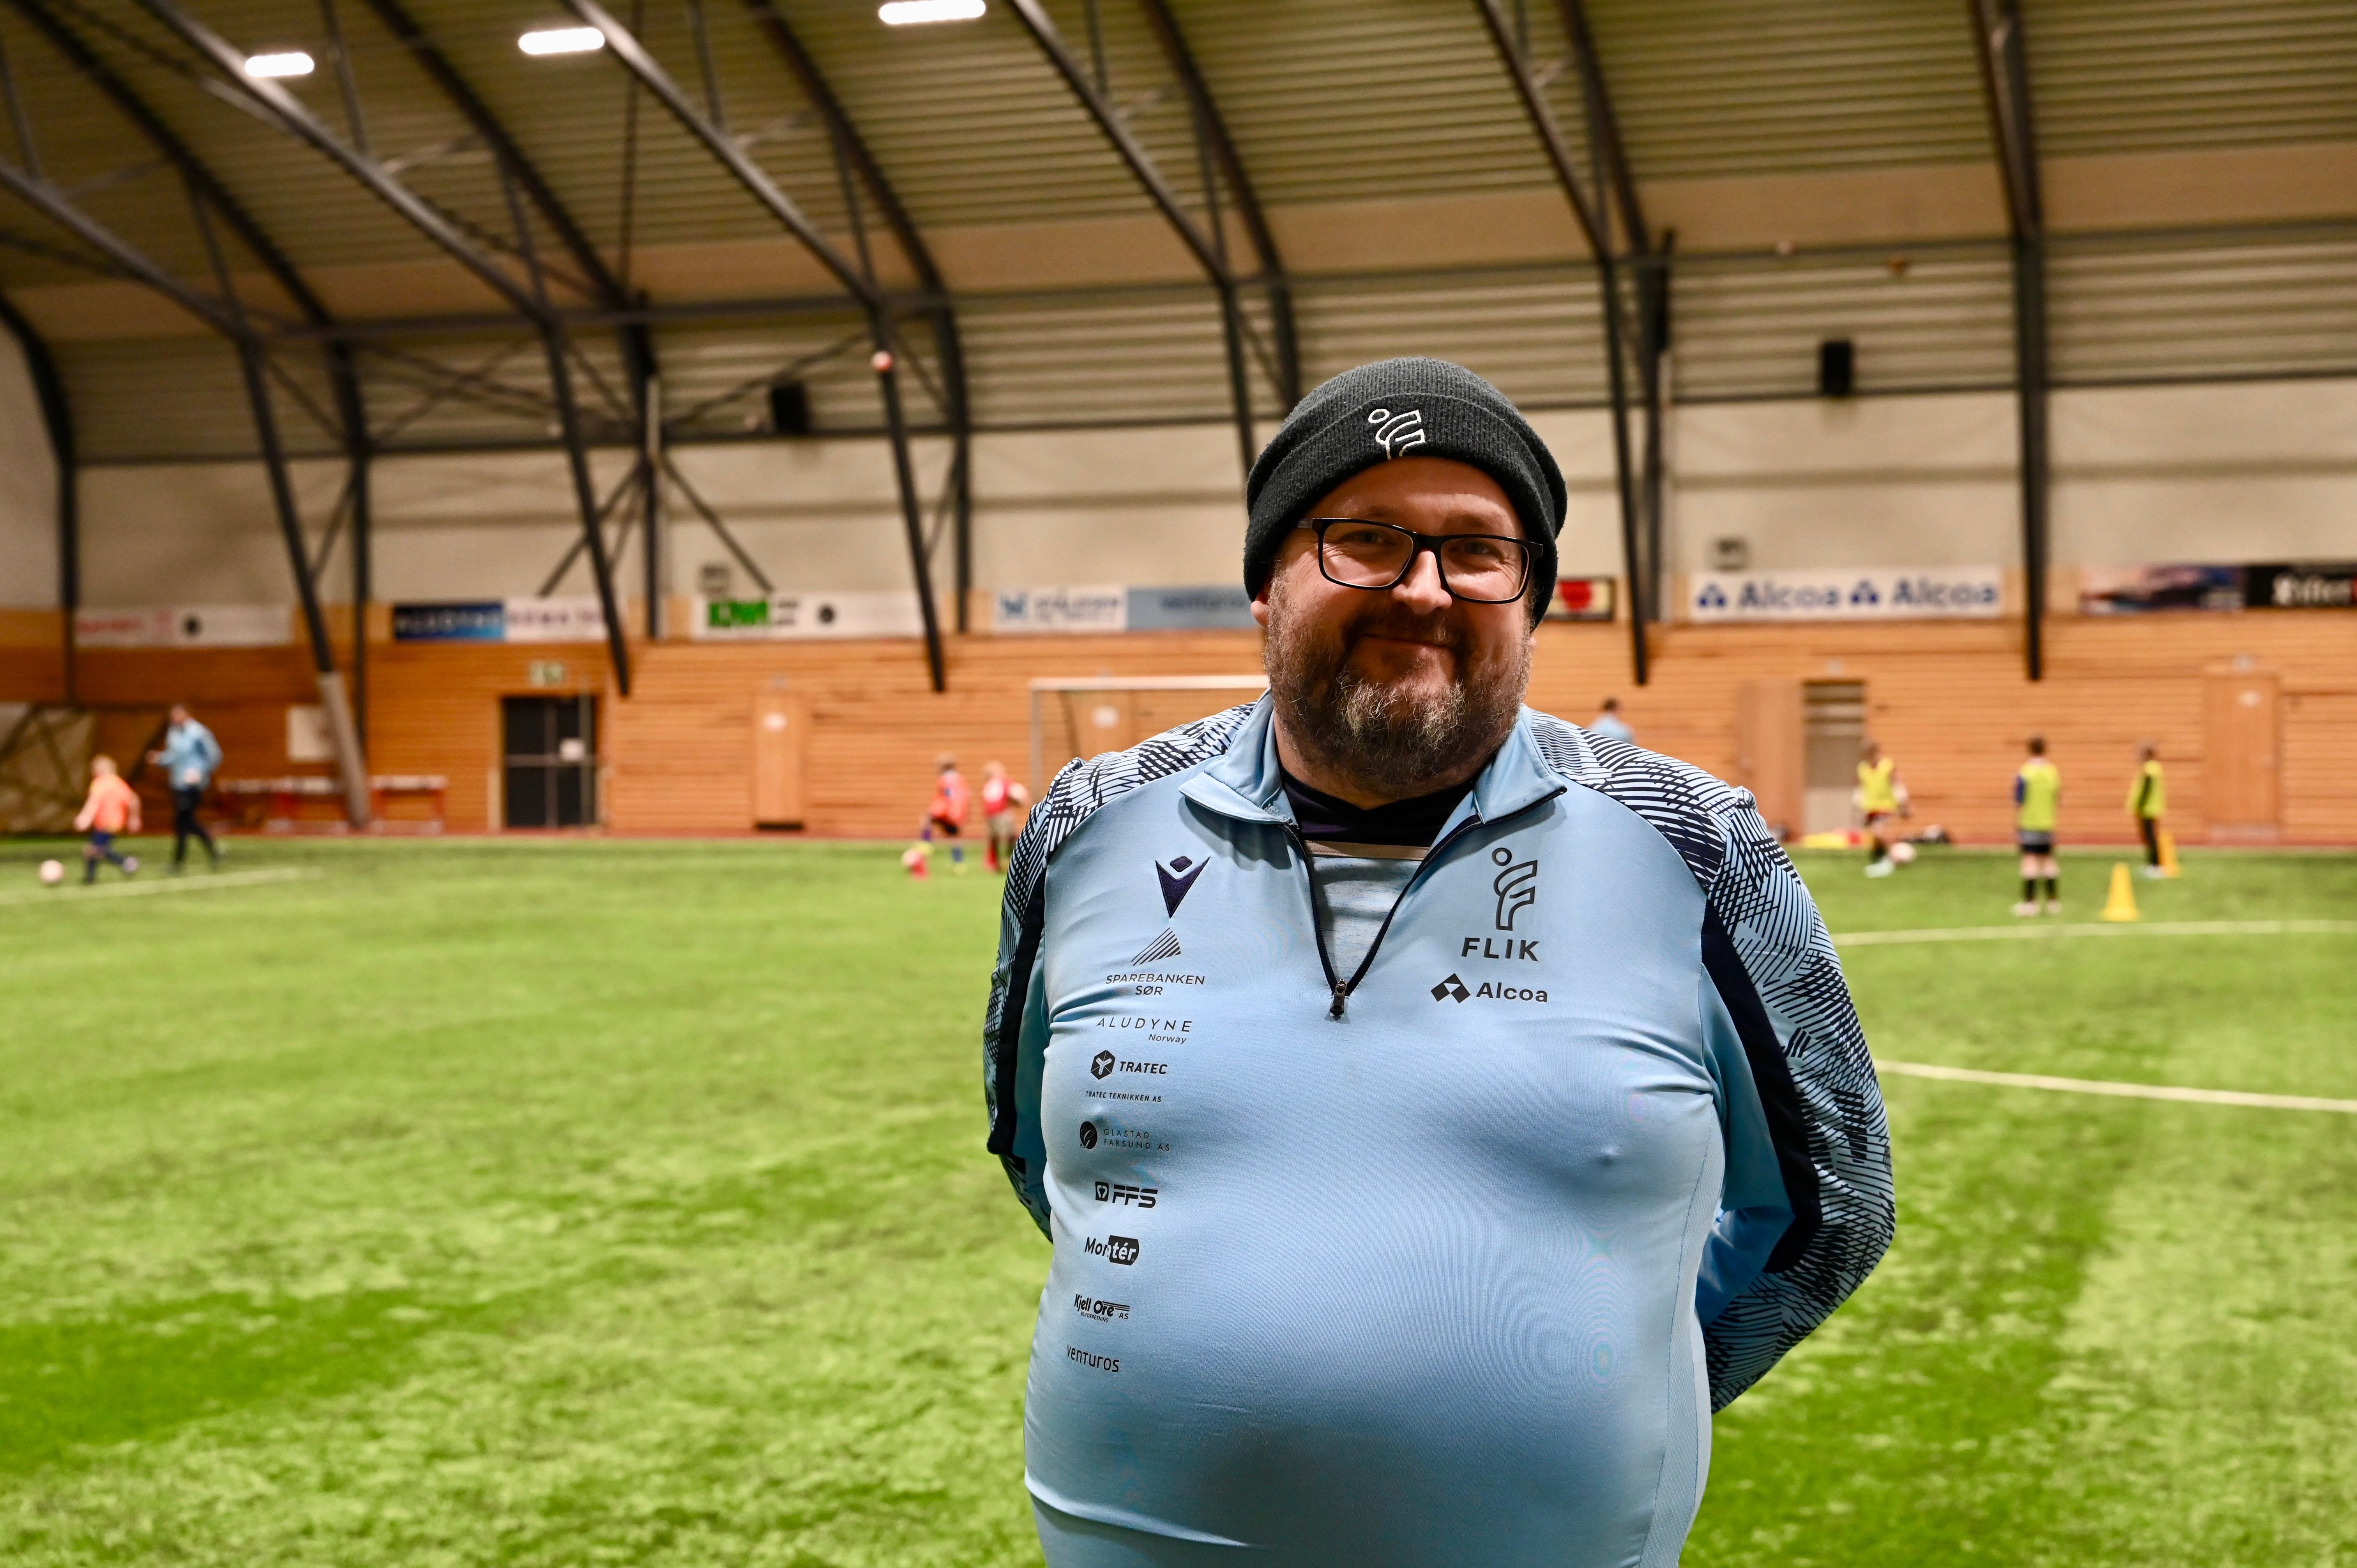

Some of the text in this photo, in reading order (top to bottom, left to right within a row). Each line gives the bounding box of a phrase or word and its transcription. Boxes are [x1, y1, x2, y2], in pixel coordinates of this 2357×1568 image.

[1736, 577, 1998, 608] Alcoa Alcoa
[1461, 937, 1540, 962] FLIK
[1106, 973, 1205, 985] SPAREBANKEN
[1135, 985, 1163, 996] SØR
[1476, 982, 1547, 1003] Alcoa
[1096, 1017, 1193, 1032] ALUDYNE
[1148, 1034, 1187, 1045] Norway
[1120, 1061, 1168, 1075] TRATEC
[1109, 1093, 1149, 1102] TEKNIKKEN
[1104, 1128, 1149, 1139] GLASTAD
[1104, 1140, 1151, 1150] FARSUND
[1112, 1184, 1158, 1208] FFS
[1084, 1236, 1137, 1261] Montér
[1074, 1293, 1092, 1312] Kjell
[1093, 1300, 1115, 1317] Ore
[1080, 1311, 1109, 1323] BILFORRETNING
